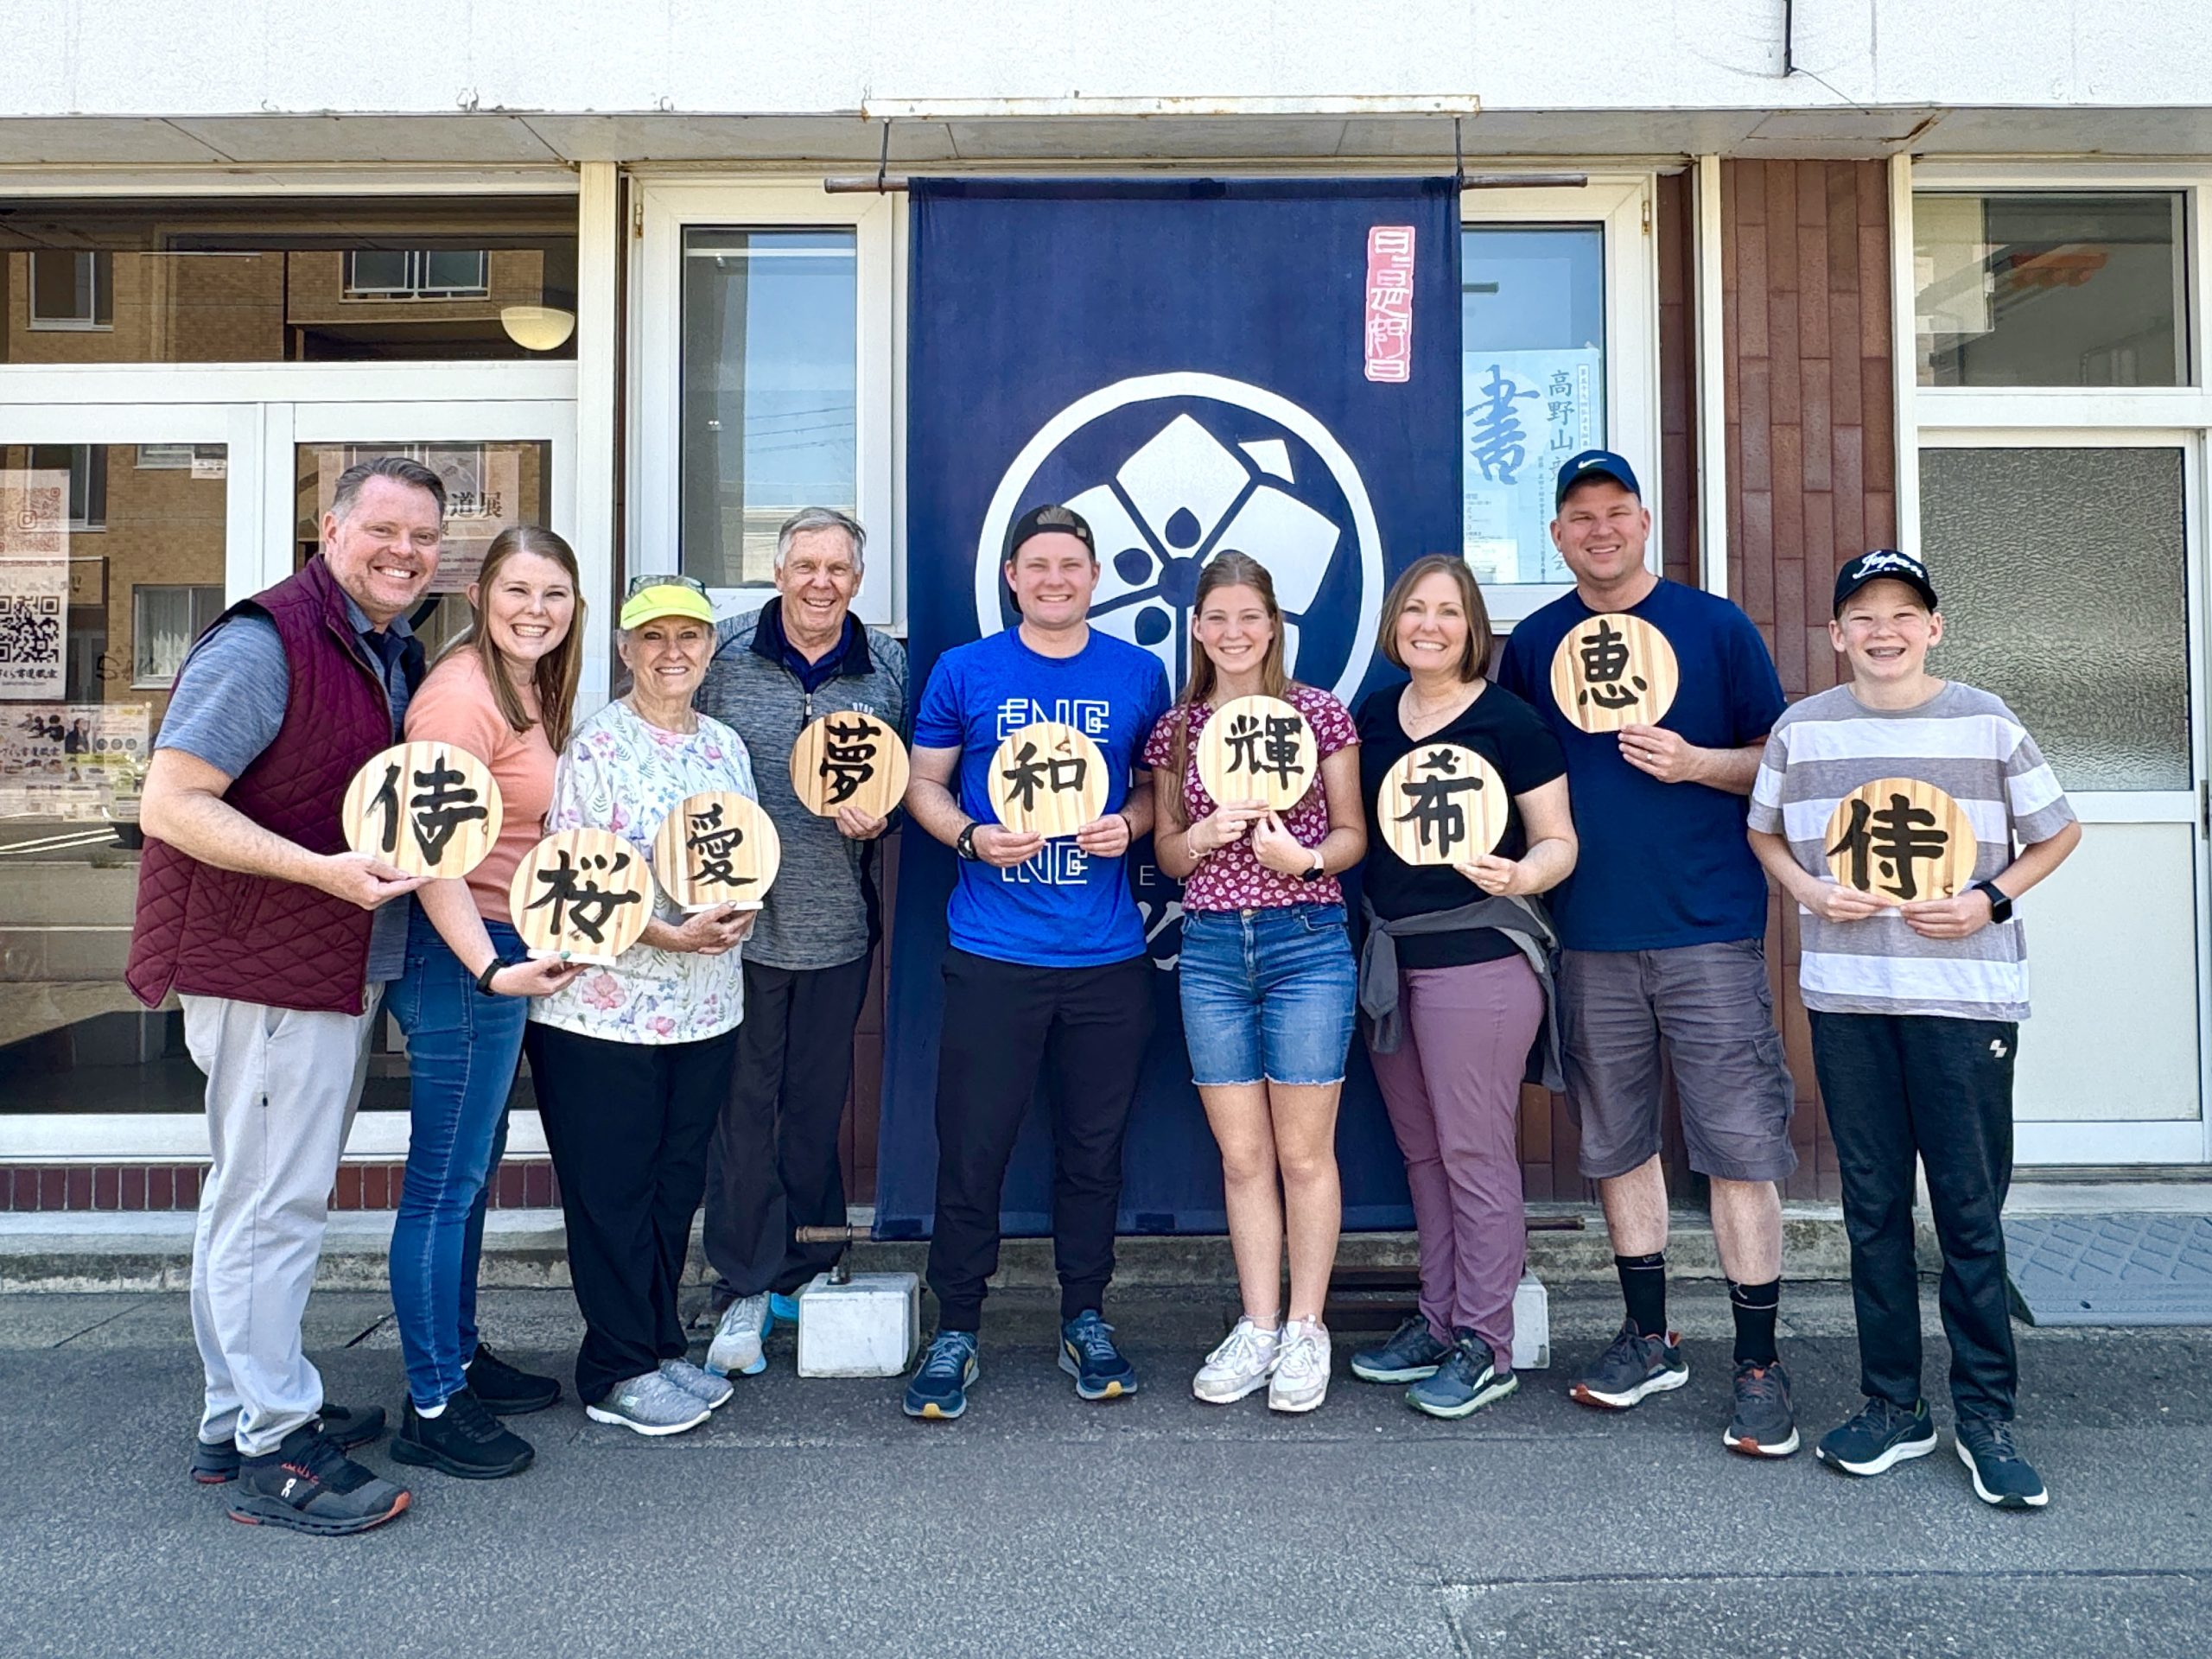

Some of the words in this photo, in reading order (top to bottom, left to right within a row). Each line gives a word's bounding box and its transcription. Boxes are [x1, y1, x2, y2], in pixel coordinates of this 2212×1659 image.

[1577, 617, 1648, 709] 恵
[819, 716, 882, 805] 夢
[1002, 741, 1087, 813] 和
[1224, 714, 1305, 791] 輝
[685, 803, 759, 887] 愛
[1392, 747, 1484, 859] 希
[1825, 792, 1949, 900] 侍
[522, 849, 642, 944] 桜
